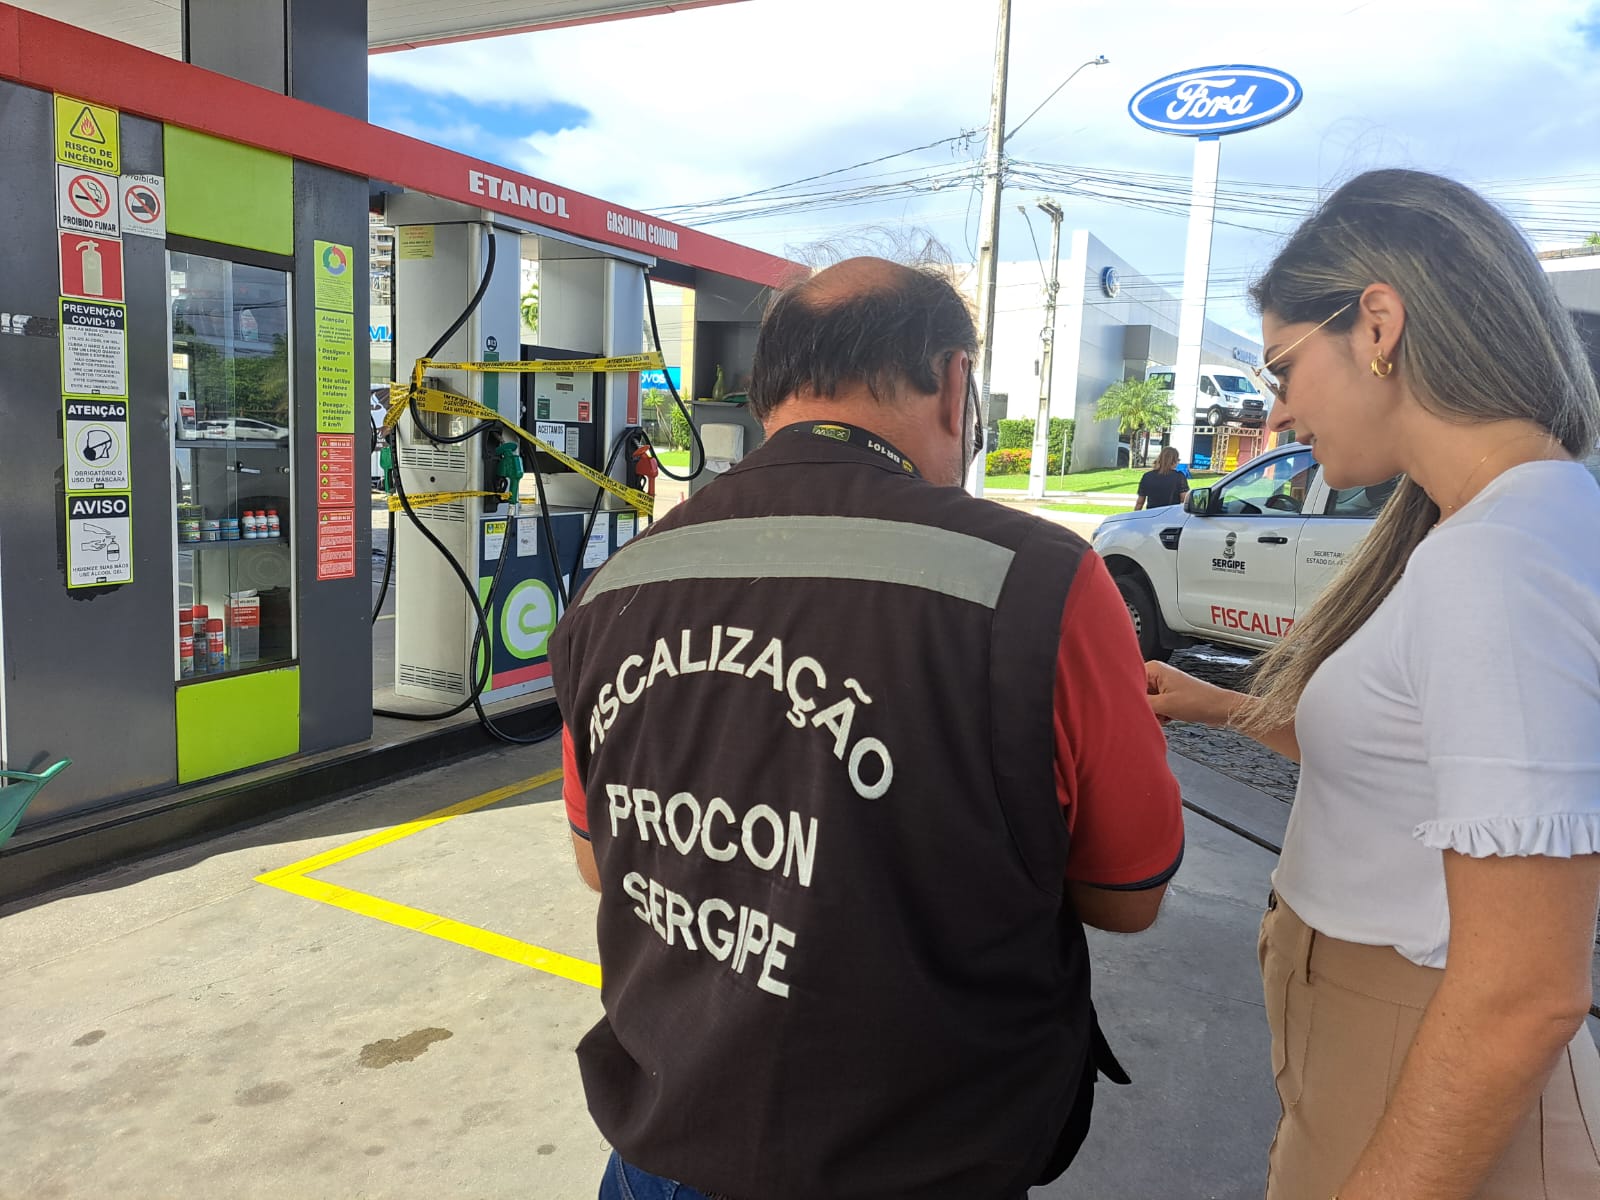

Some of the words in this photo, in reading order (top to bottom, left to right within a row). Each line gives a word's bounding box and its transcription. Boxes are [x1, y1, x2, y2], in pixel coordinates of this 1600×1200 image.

[1166, 79, 1258, 120] Ford
[65, 141, 96, 154] RISCO
[100, 149, 112, 158] DE
[64, 150, 114, 168] INCÊNDIO
[468, 170, 569, 219] ETANOL
[63, 215, 93, 228] PROIBIDO
[95, 221, 116, 232] FUMAR
[606, 210, 646, 240] GASOLINA
[648, 219, 678, 250] COMUM
[63, 304, 123, 318] PREVENÇÃO
[72, 316, 115, 327] COVID-19
[68, 404, 125, 418] ATENÇÃO
[538, 425, 564, 434] ACEITAMOS
[72, 500, 127, 515] AVISO
[1212, 558, 1245, 570] SERGIPE
[605, 783, 818, 888] PROCON
[623, 872, 796, 998] SERGIPE
